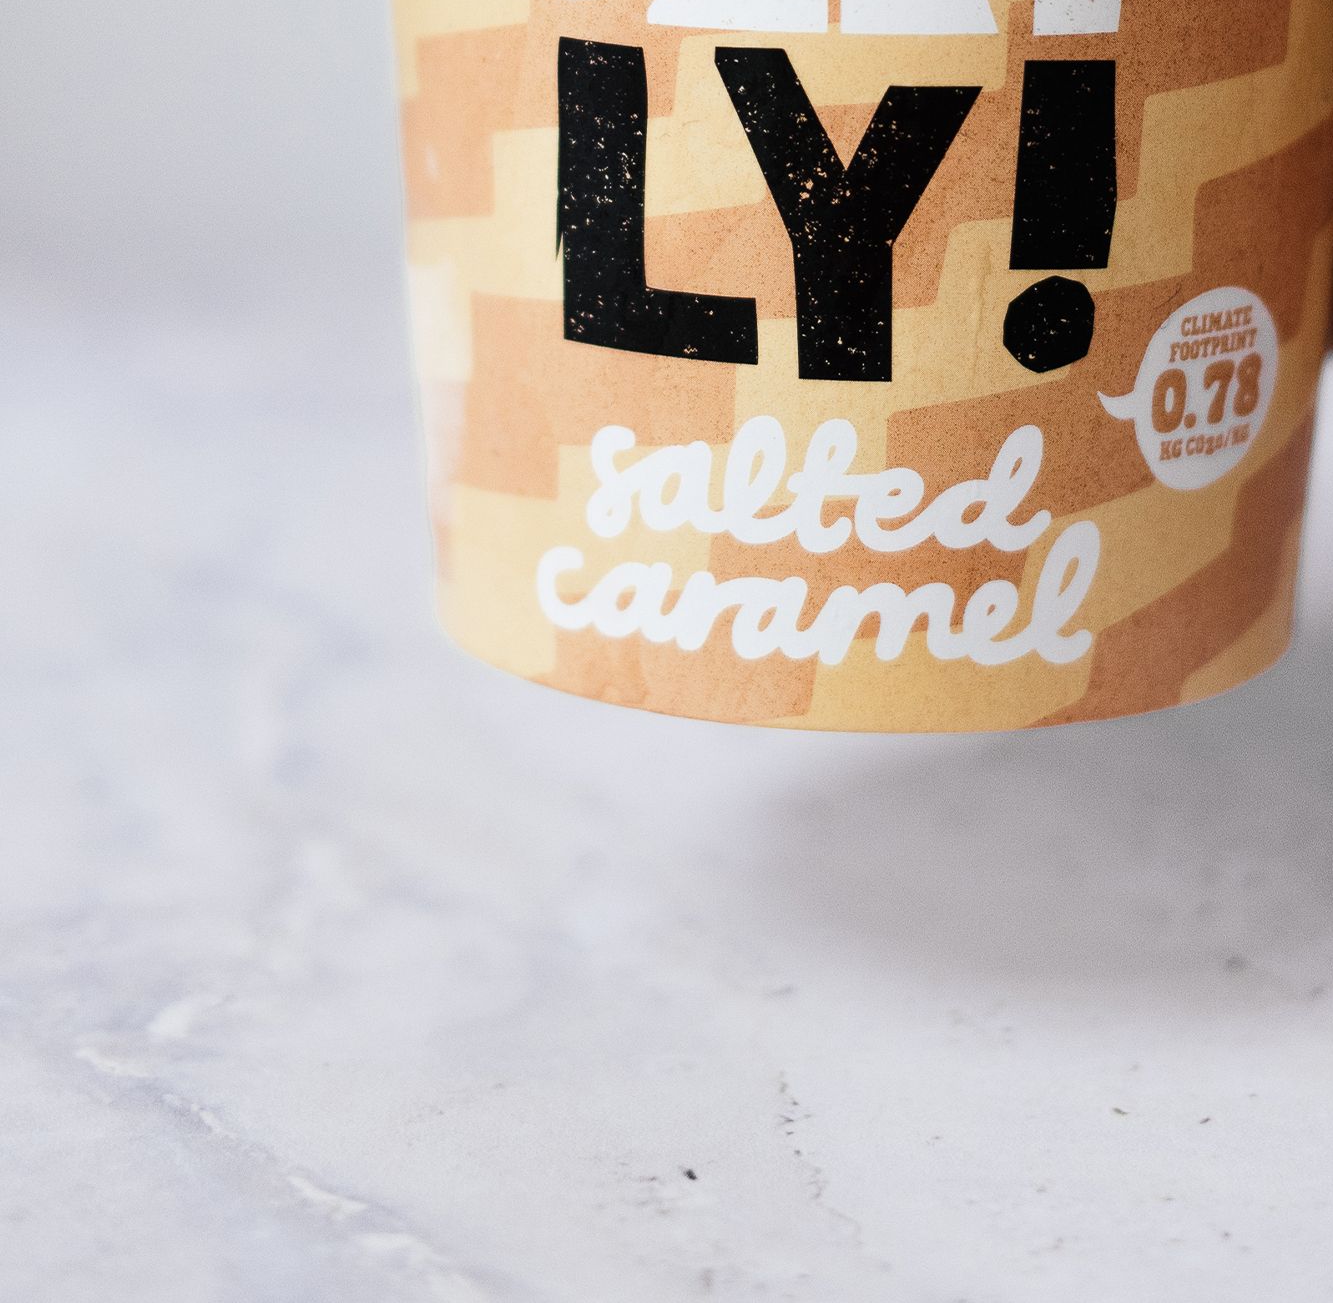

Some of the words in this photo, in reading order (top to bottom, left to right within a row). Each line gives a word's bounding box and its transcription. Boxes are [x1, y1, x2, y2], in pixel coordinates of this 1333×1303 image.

[556, 36, 1118, 382] LY!
[1169, 327, 1258, 362] FOOTPRINT
[1181, 304, 1253, 337] CLIMATE
[1152, 350, 1263, 433] 0.78
[587, 416, 1053, 553] salted
[1160, 439, 1182, 461] KG
[534, 520, 1101, 666] caramel
